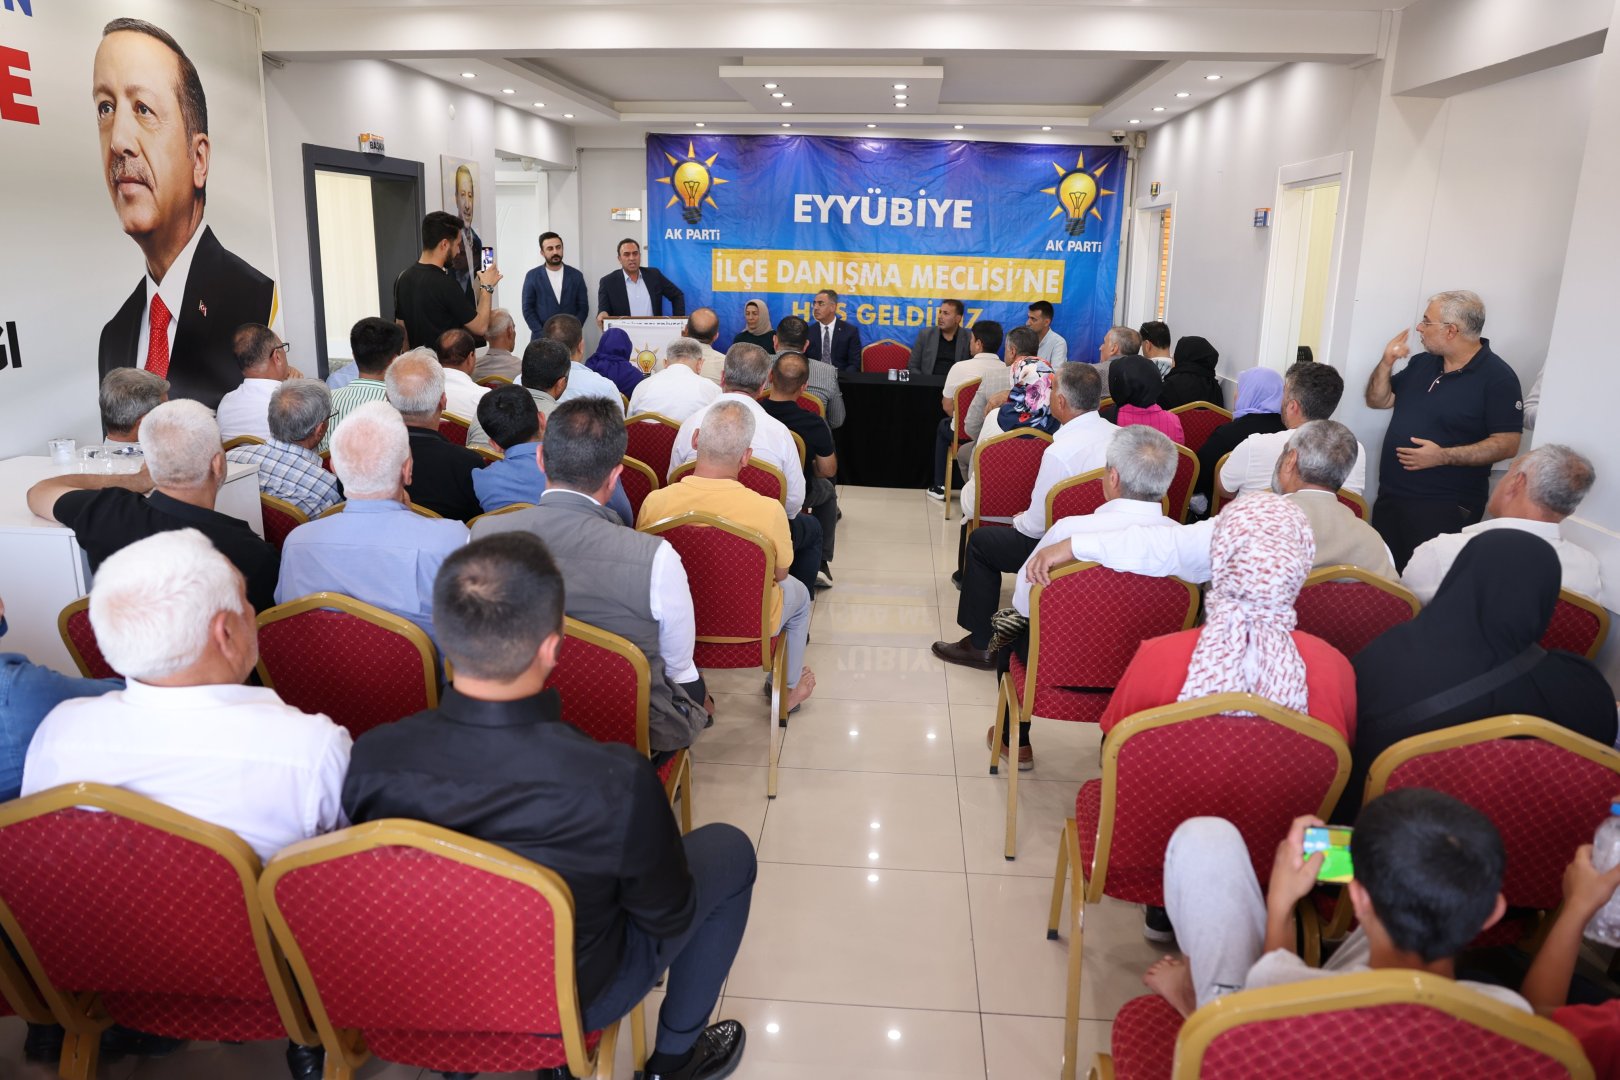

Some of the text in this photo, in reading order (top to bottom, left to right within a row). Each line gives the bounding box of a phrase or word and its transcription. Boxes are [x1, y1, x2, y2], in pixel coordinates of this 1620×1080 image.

[794, 187, 973, 229] EYYÜBİYE
[664, 228, 683, 240] AK
[1045, 239, 1064, 252] AK
[716, 251, 1060, 294] İLÇE DANIŞMA MECLİSİ'NE
[856, 300, 983, 329] GELDİZ
